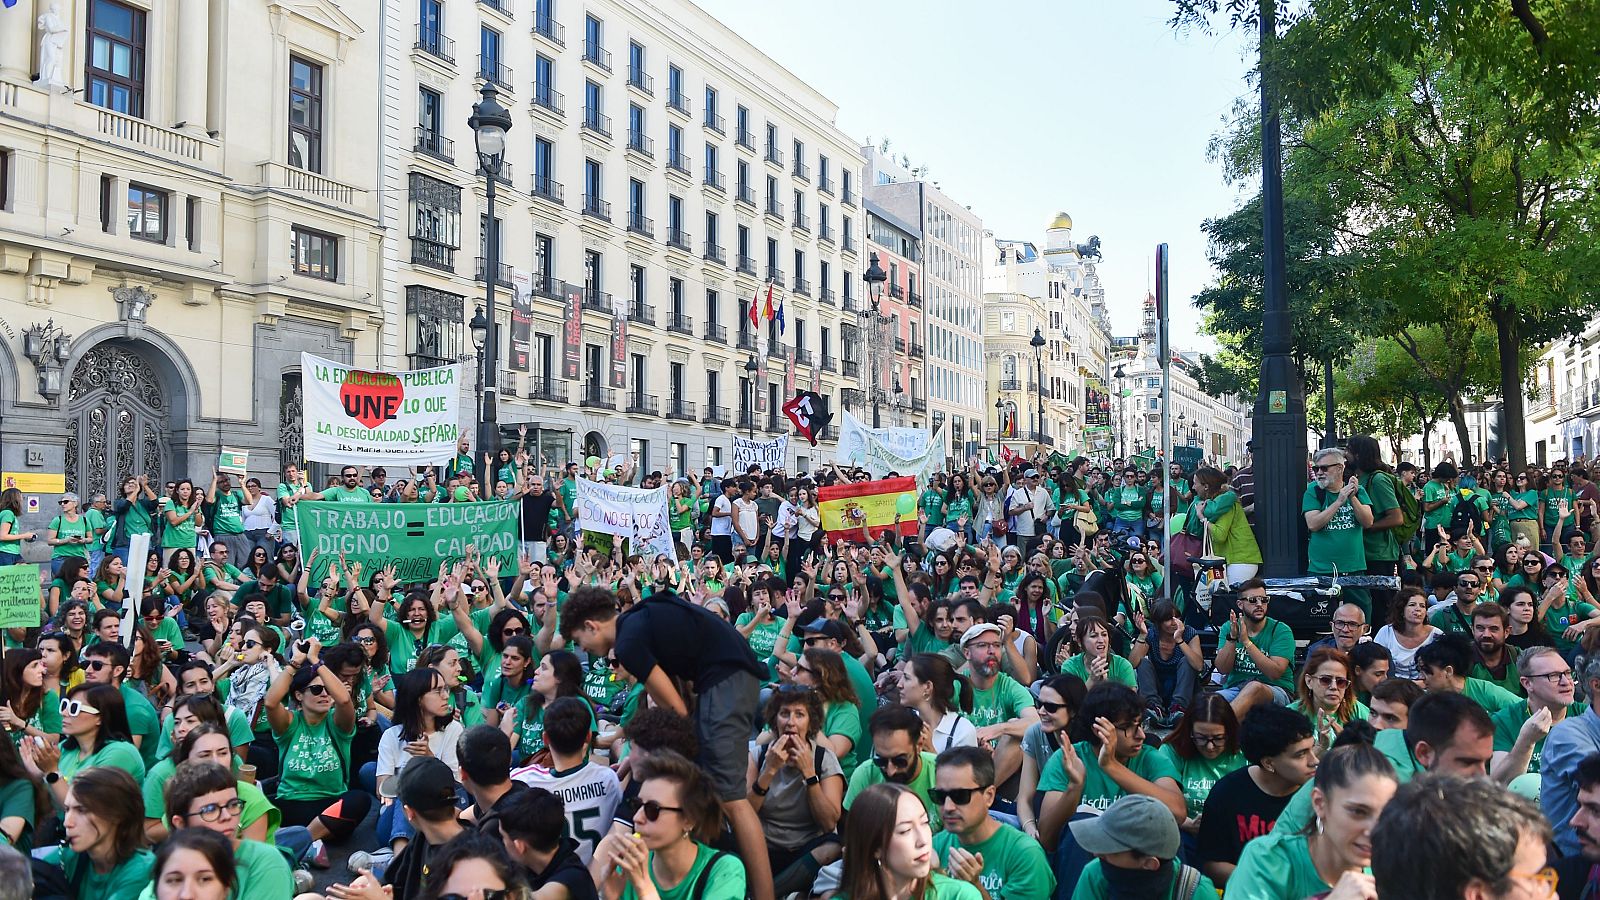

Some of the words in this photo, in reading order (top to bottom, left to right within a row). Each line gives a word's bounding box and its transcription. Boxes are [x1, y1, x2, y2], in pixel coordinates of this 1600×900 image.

[316, 365, 329, 382] LA
[344, 394, 398, 420] UNE
[403, 399, 420, 414] LO
[424, 396, 447, 413] QUE
[317, 421, 333, 436] LA
[337, 426, 410, 442] DESIGUALDAD
[411, 423, 458, 444] SEPARA
[30, 451, 44, 462] 34
[337, 443, 353, 452] IES
[310, 509, 406, 530] TRABAJO
[470, 524, 484, 533] DE
[318, 533, 390, 555] DIGNO
[434, 532, 514, 557] CALIDAD
